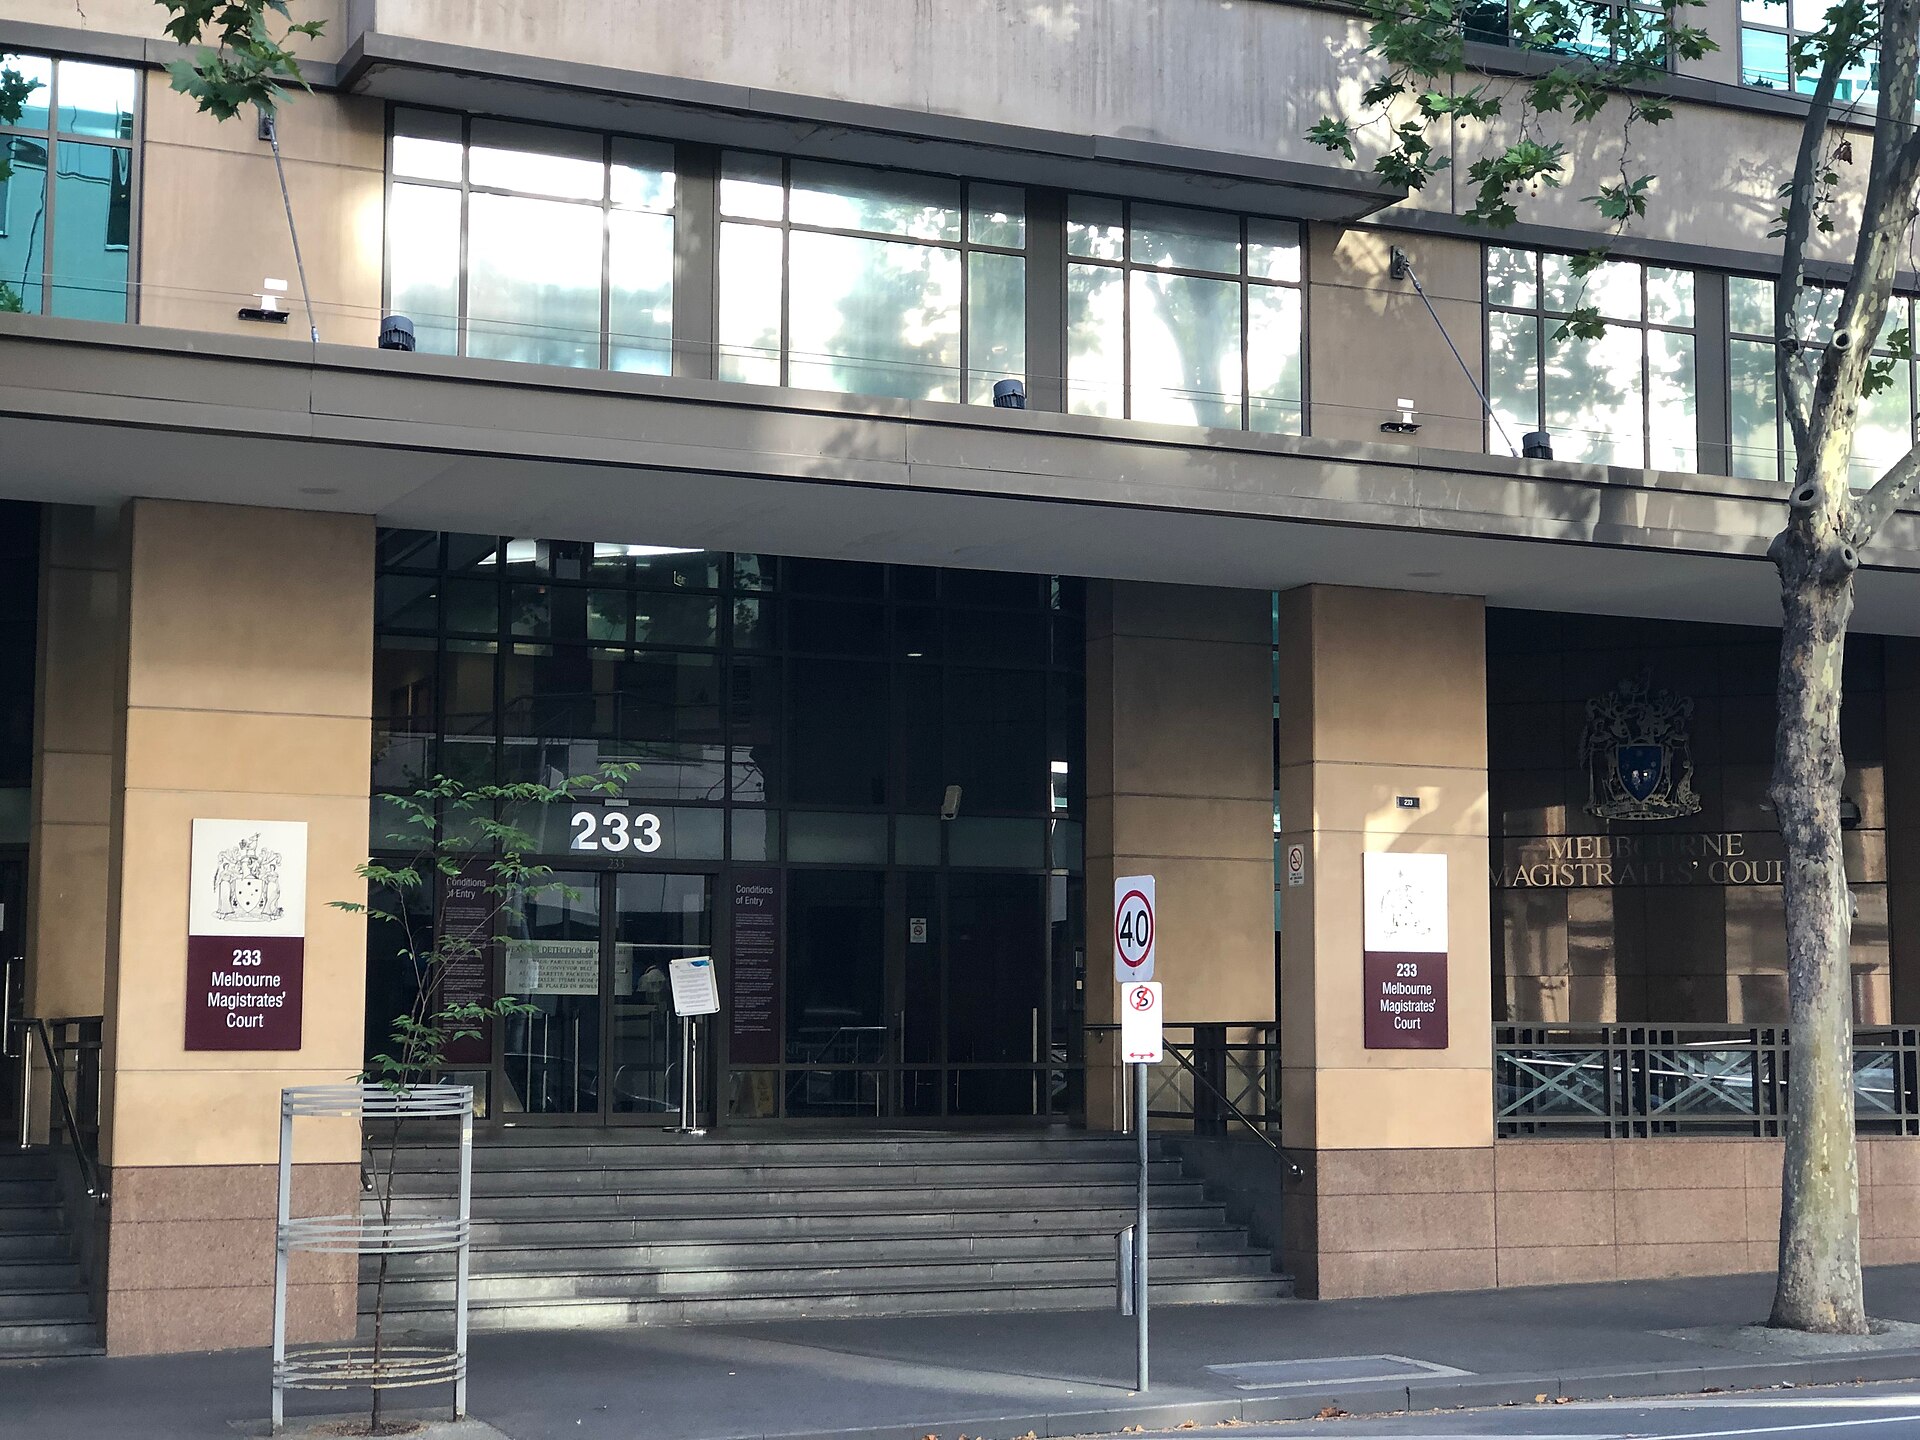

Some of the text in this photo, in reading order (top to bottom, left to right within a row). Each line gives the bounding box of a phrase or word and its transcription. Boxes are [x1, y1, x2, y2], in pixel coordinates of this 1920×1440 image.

[570, 811, 662, 853] 233
[1547, 833, 1746, 860] MELBOURNE
[607, 858, 625, 870] 233
[1707, 860, 1784, 885] COU
[455, 889, 476, 900] Entry
[735, 884, 774, 895] Conditions
[735, 896, 764, 907] of Entry
[1119, 909, 1149, 948] 40
[232, 949, 262, 967] 233
[1396, 962, 1418, 978] 233
[211, 971, 281, 988] Melbourne
[1382, 981, 1432, 996] Melbourne
[207, 991, 286, 1010] Magistrates'
[1379, 998, 1437, 1015] Magistrates'
[226, 1012, 264, 1028] Court
[1394, 1016, 1421, 1030] Court
